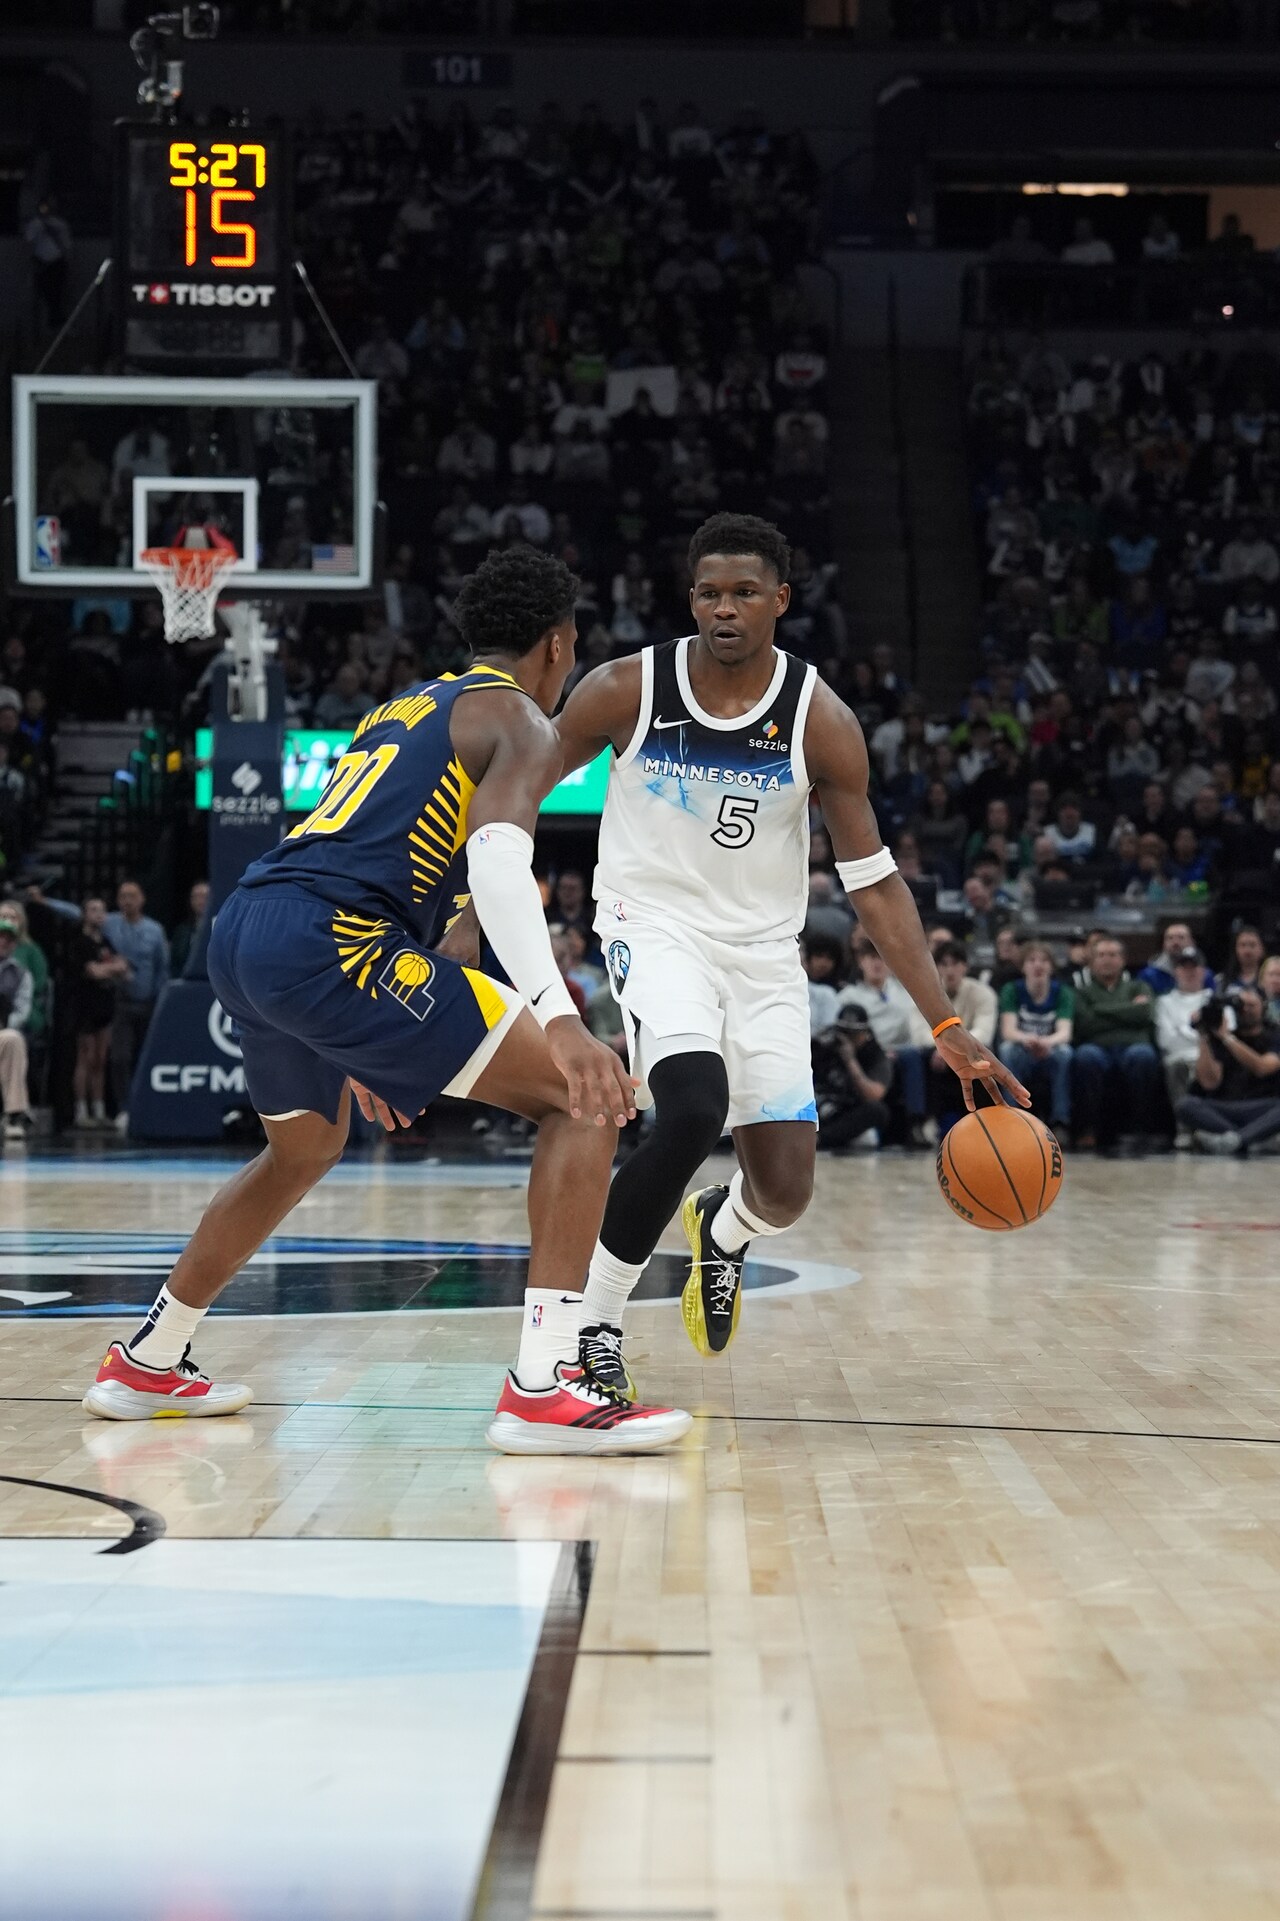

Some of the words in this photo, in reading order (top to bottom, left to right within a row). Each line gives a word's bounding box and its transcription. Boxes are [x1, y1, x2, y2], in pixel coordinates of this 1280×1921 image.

[431, 56, 484, 85] 101
[169, 142, 266, 188] 5:27
[184, 189, 257, 268] 15
[171, 284, 276, 307] TISSOT
[747, 736, 789, 753] sezzle
[643, 757, 781, 792] MINNESOTA
[710, 794, 759, 850] 5
